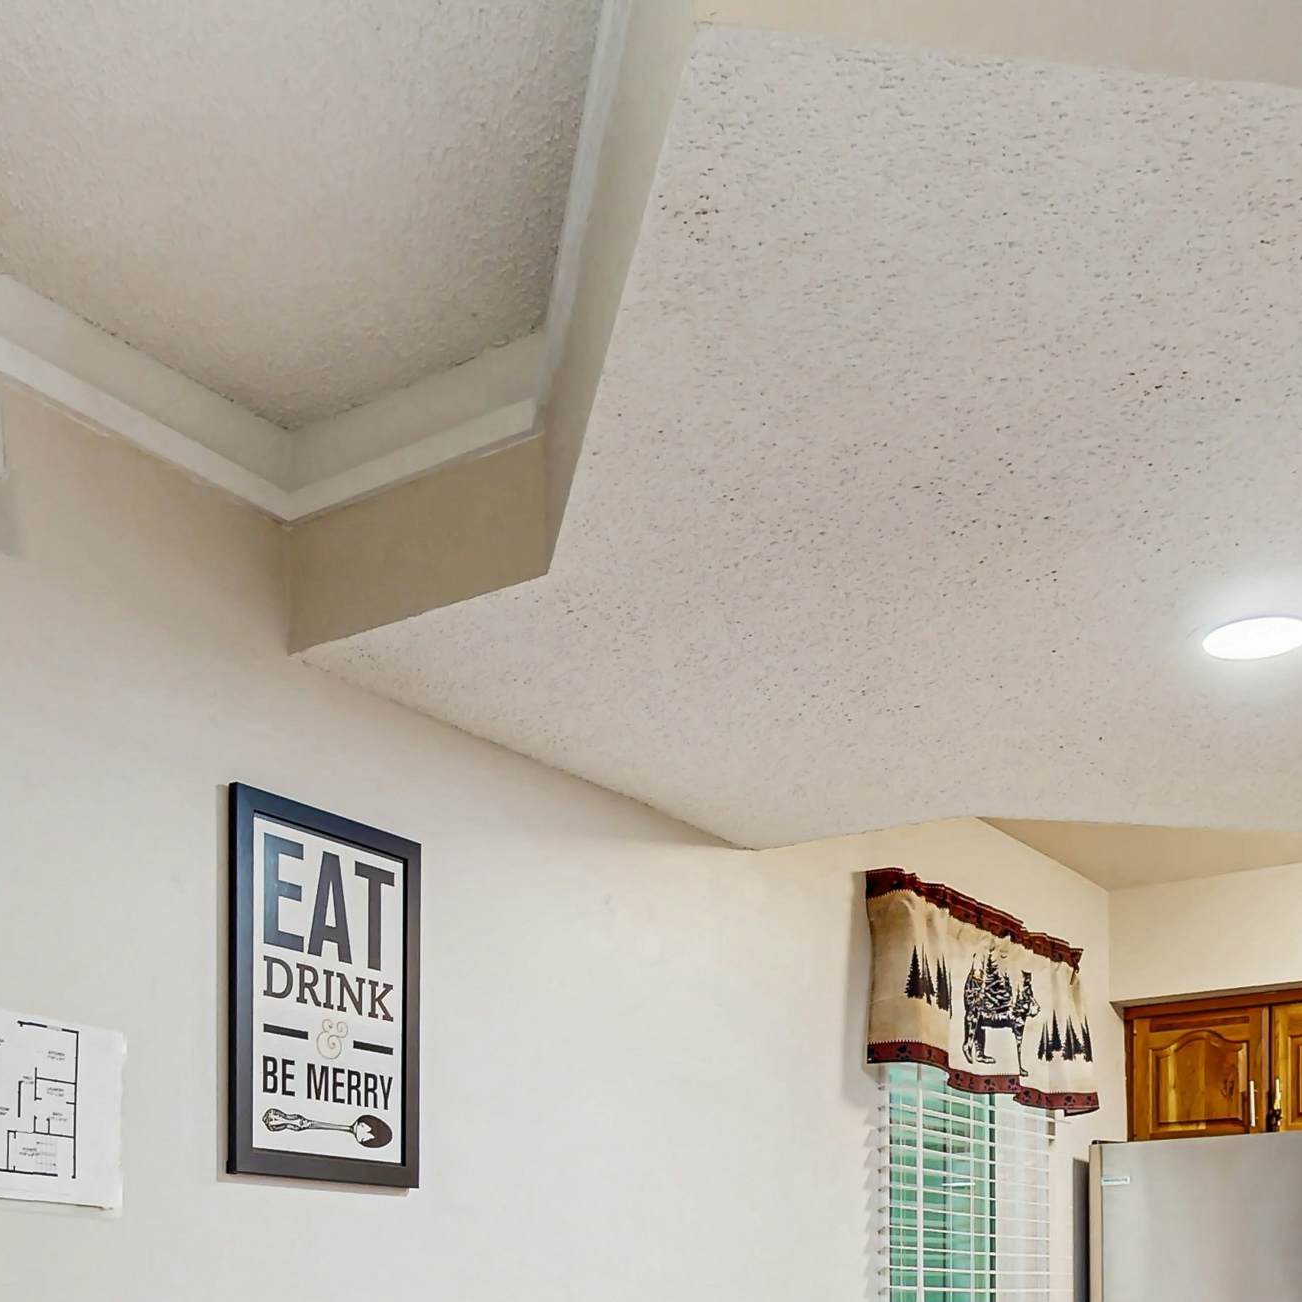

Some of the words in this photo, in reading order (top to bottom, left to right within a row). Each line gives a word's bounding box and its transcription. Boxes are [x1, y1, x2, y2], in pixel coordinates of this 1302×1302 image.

[263, 831, 395, 971] EAT
[262, 955, 395, 1023] DRINK
[316, 1018, 349, 1060] &
[262, 1055, 296, 1098] BE
[305, 1062, 394, 1112] MERRY
